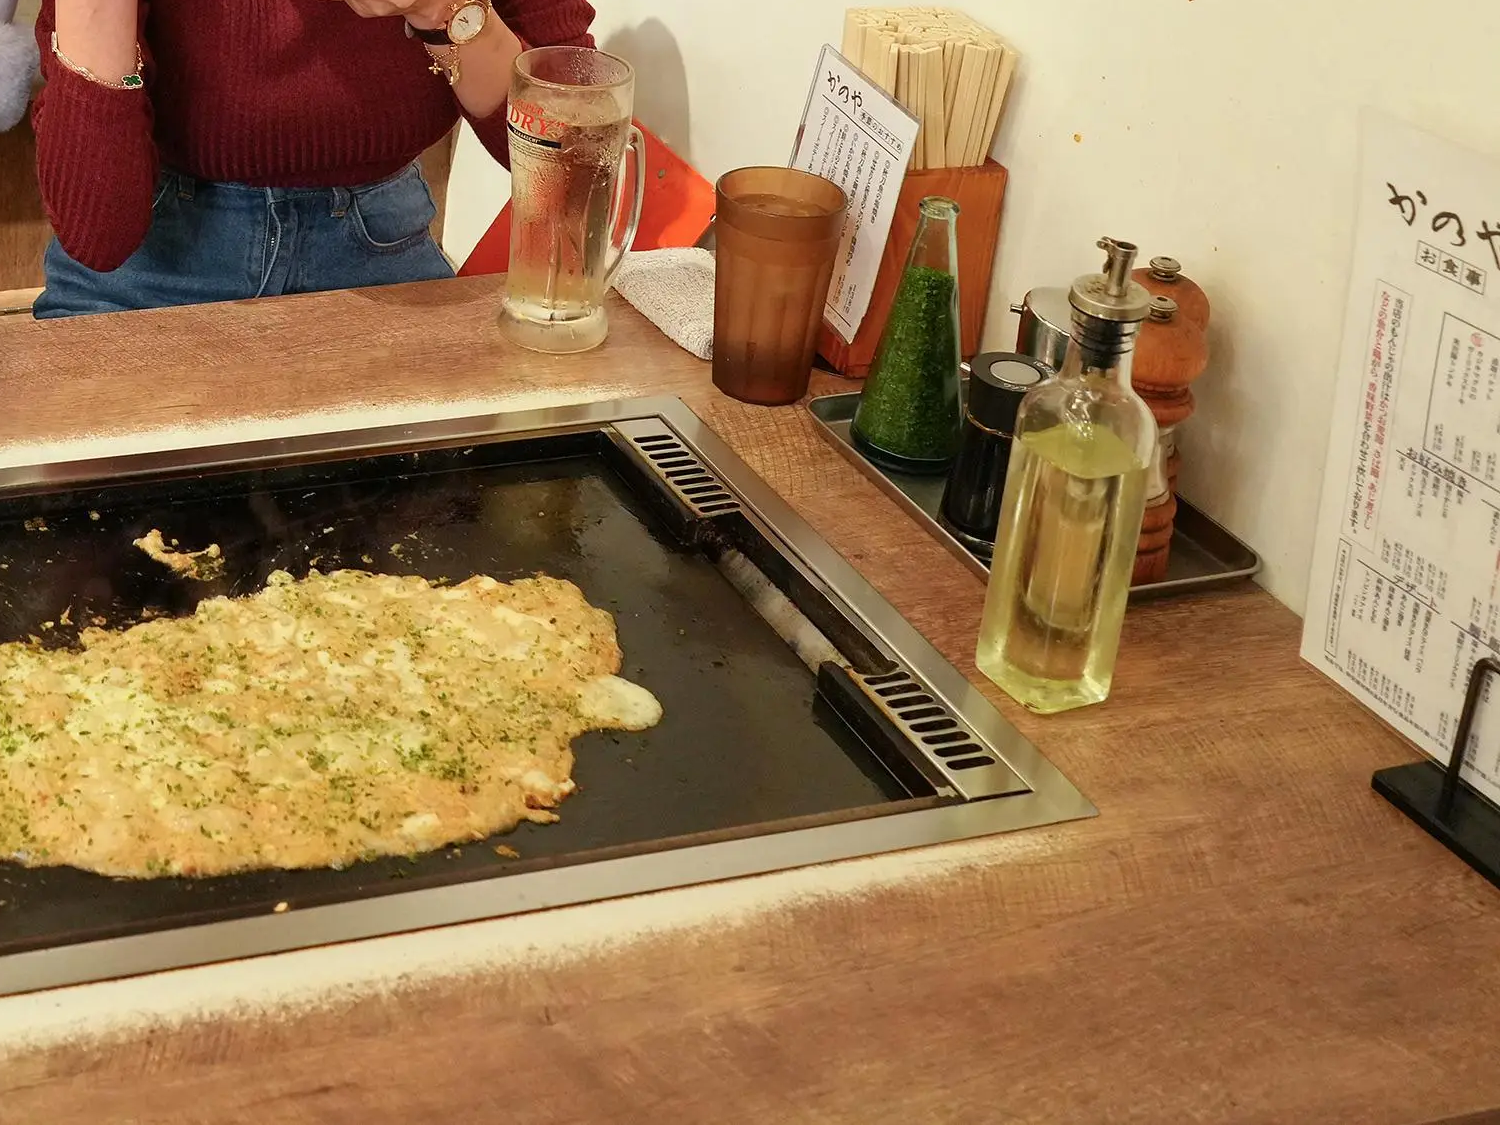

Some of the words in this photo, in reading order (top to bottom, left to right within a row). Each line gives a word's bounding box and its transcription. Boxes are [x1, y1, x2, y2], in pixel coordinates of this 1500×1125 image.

[828, 70, 862, 115] かのや
[1420, 248, 1483, 286] お食事
[1407, 448, 1467, 489] お好み焼き
[1393, 574, 1437, 608] デザート
